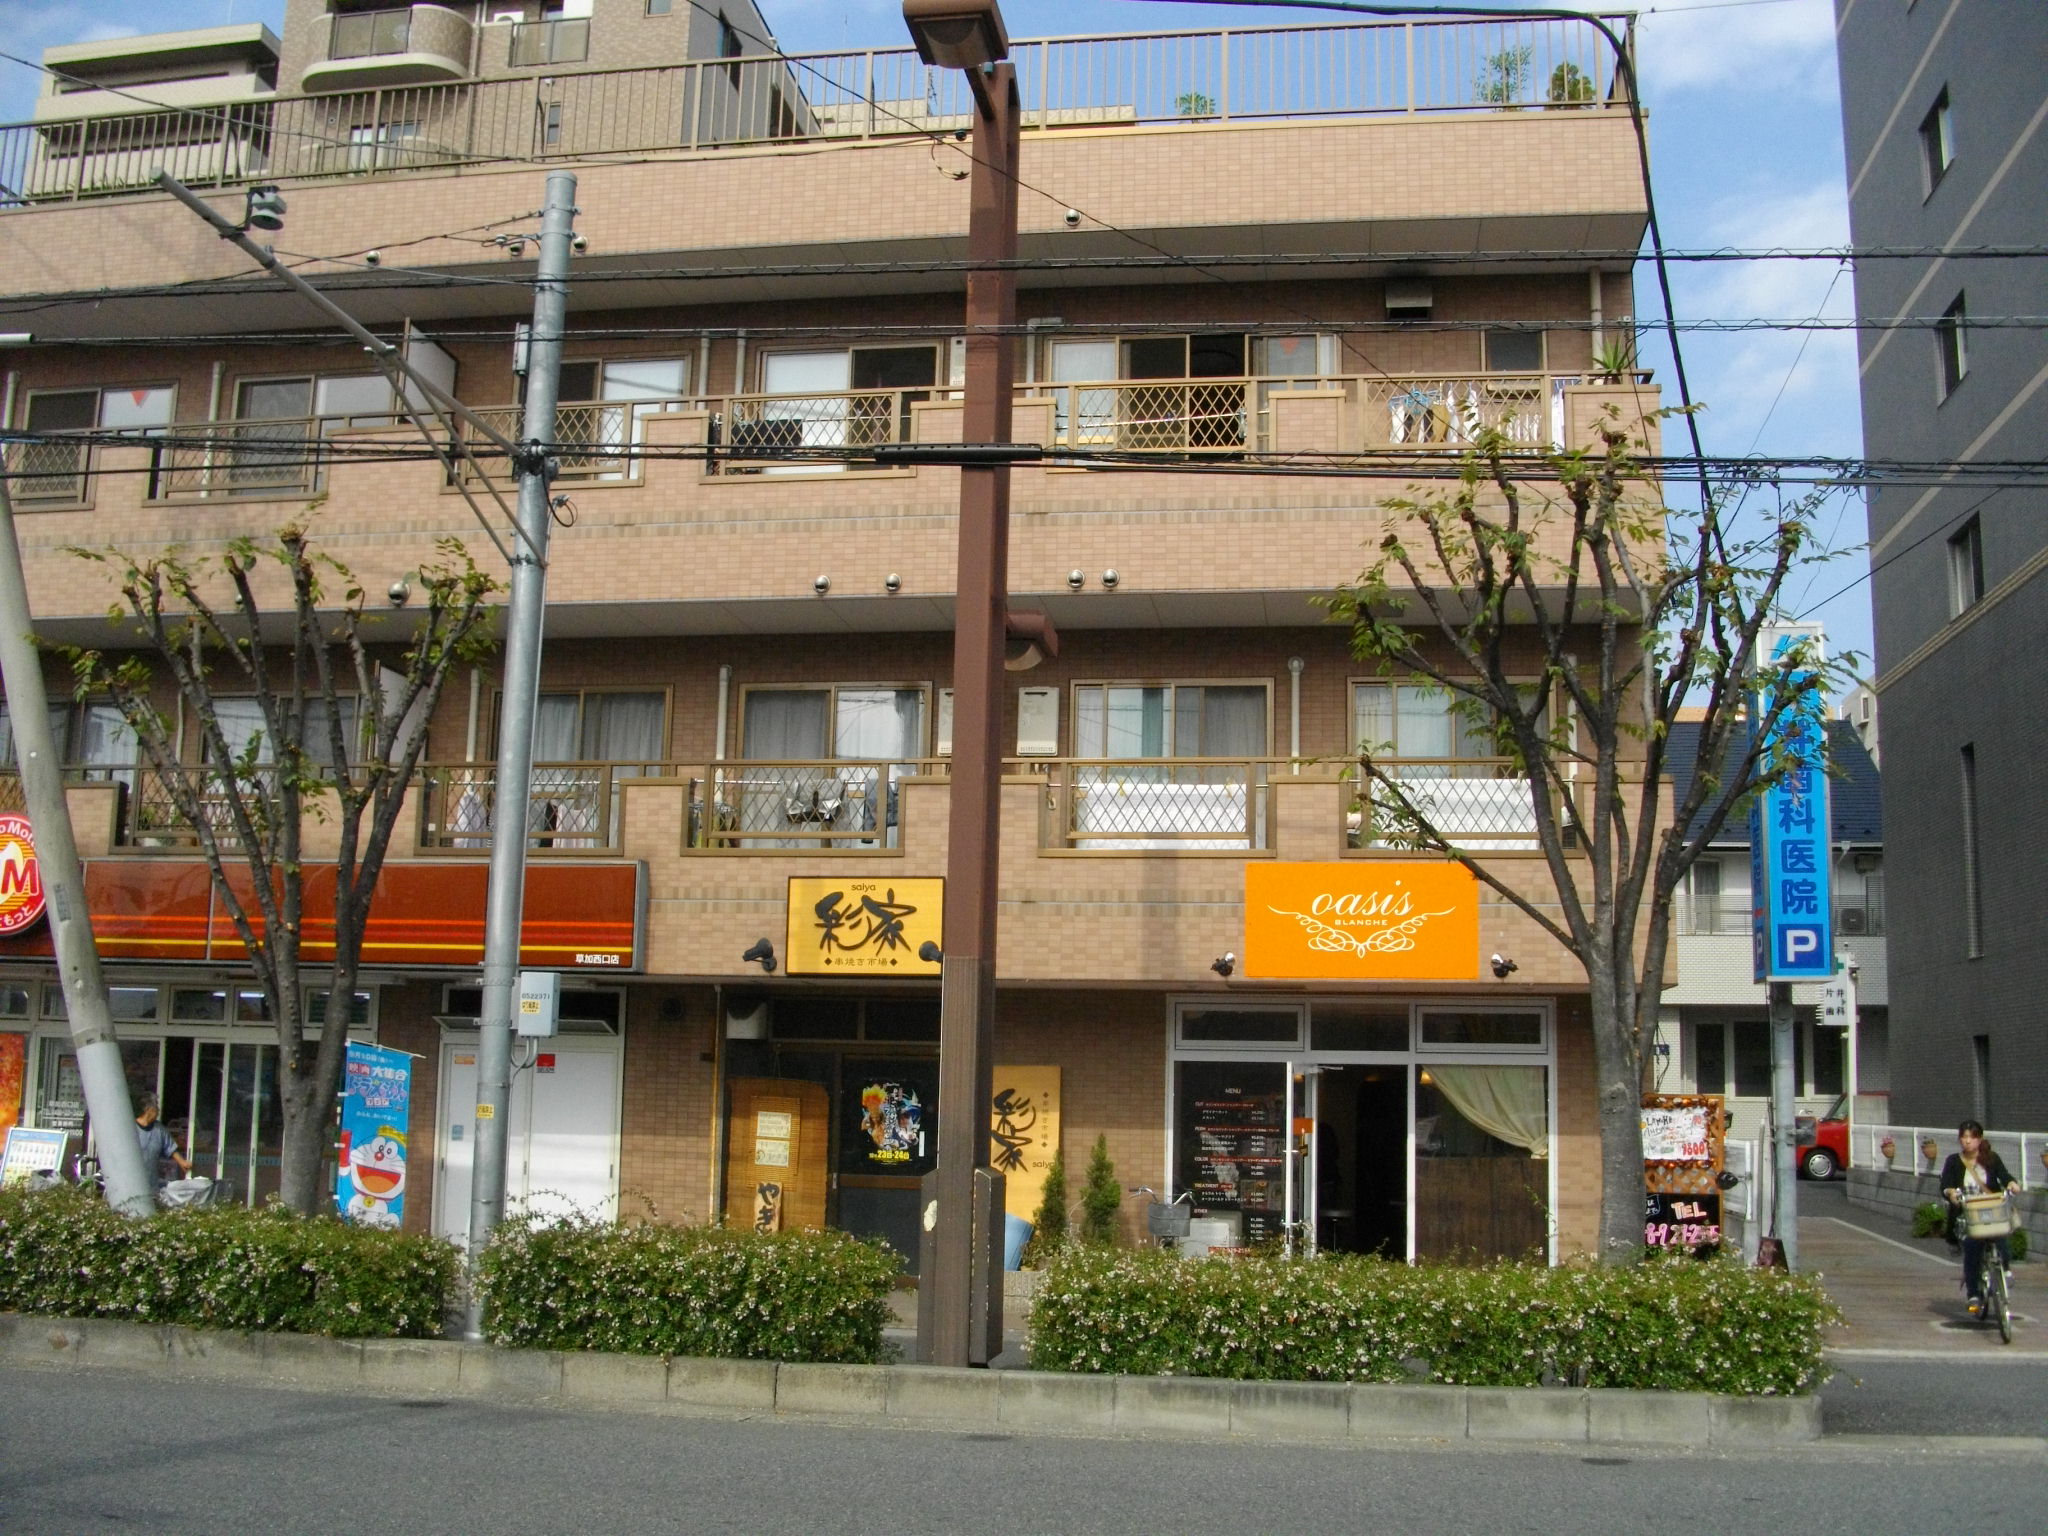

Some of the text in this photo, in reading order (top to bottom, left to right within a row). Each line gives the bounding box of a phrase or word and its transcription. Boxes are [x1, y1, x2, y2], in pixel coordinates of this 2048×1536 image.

[851, 883, 876, 893] saiya
[1311, 880, 1414, 916] oasis
[1786, 929, 1817, 963] P
[575, 953, 620, 965] 草加西口店
[1671, 1201, 1707, 1220] TEL
